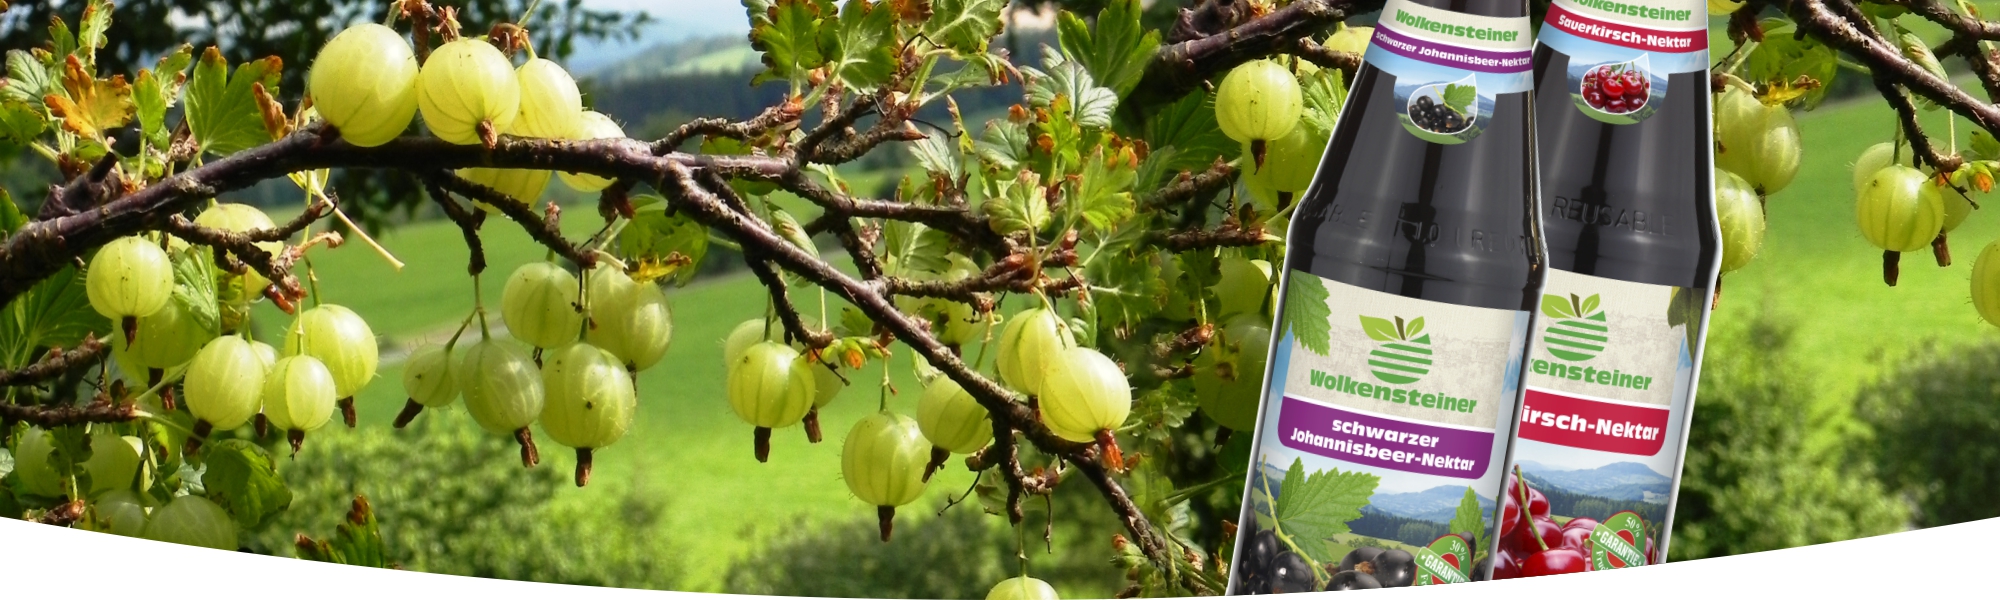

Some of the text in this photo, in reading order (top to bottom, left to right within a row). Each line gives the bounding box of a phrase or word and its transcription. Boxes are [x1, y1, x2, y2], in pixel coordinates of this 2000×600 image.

[1396, 9, 1519, 42] Wolkensteiner
[1573, 0, 1691, 21] olkensteiner
[1558, 14, 1692, 48] Sauerkirsch-Nektar
[1375, 31, 1531, 67] schwarzer Johannisbeer-Nektar
[1550, 196, 1675, 237] REUSABLE
[1310, 369, 1477, 413] Wolkensteiner
[1332, 419, 1440, 448] schwarzer
[1521, 405, 1660, 440] irsch-Nektar
[1290, 428, 1475, 471] Johannisbeer-Nektar
[1600, 531, 1640, 567] GARANTIE
